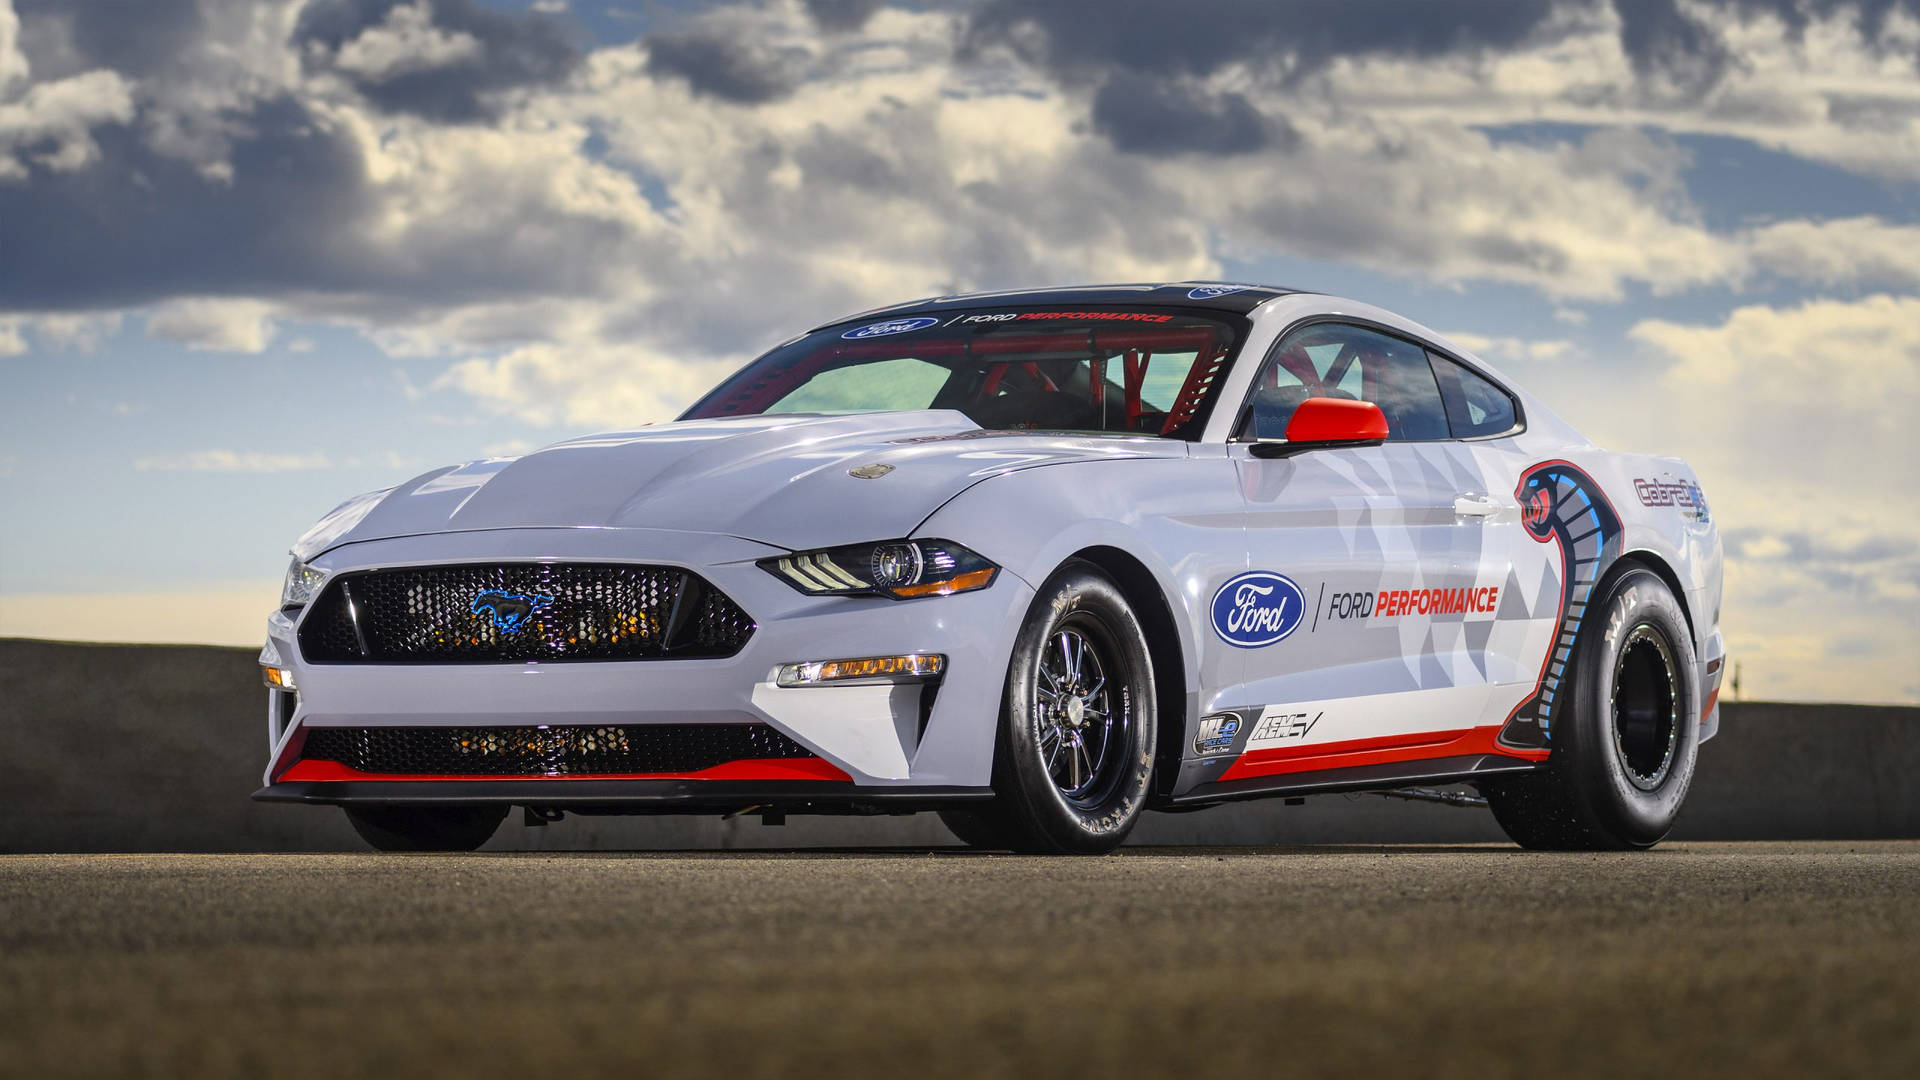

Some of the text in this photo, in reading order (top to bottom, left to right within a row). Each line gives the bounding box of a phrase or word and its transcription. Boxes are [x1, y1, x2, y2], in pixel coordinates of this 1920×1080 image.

[856, 319, 921, 337] Ford
[962, 312, 1173, 324] FORD PERFORMANCE
[1227, 583, 1284, 634] Ford
[1328, 587, 1499, 620] FORD PERFORMANCE
